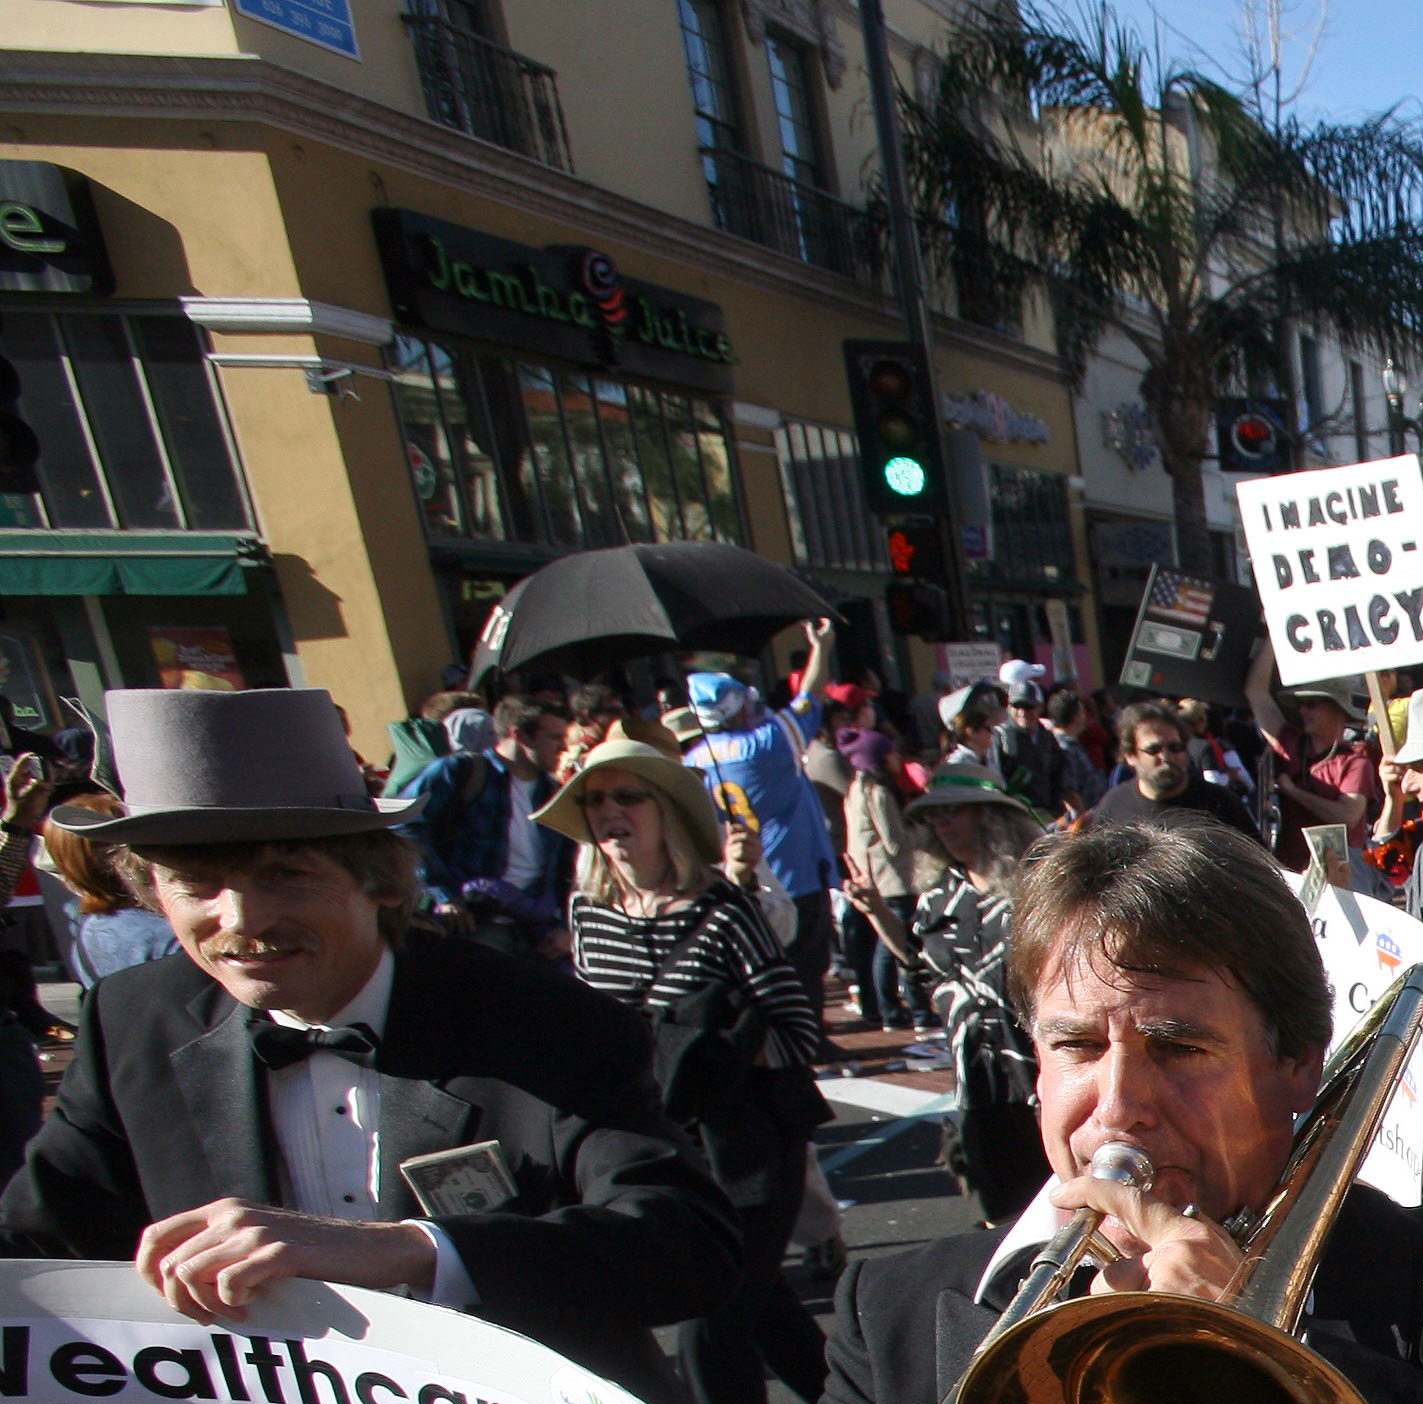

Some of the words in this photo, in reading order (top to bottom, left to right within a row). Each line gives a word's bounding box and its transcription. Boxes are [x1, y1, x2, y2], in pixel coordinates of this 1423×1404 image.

[428, 235, 597, 328] Jamba
[637, 297, 738, 365] Juice
[1261, 478, 1405, 533] IMAGINE
[1271, 537, 1418, 590] DEMO-
